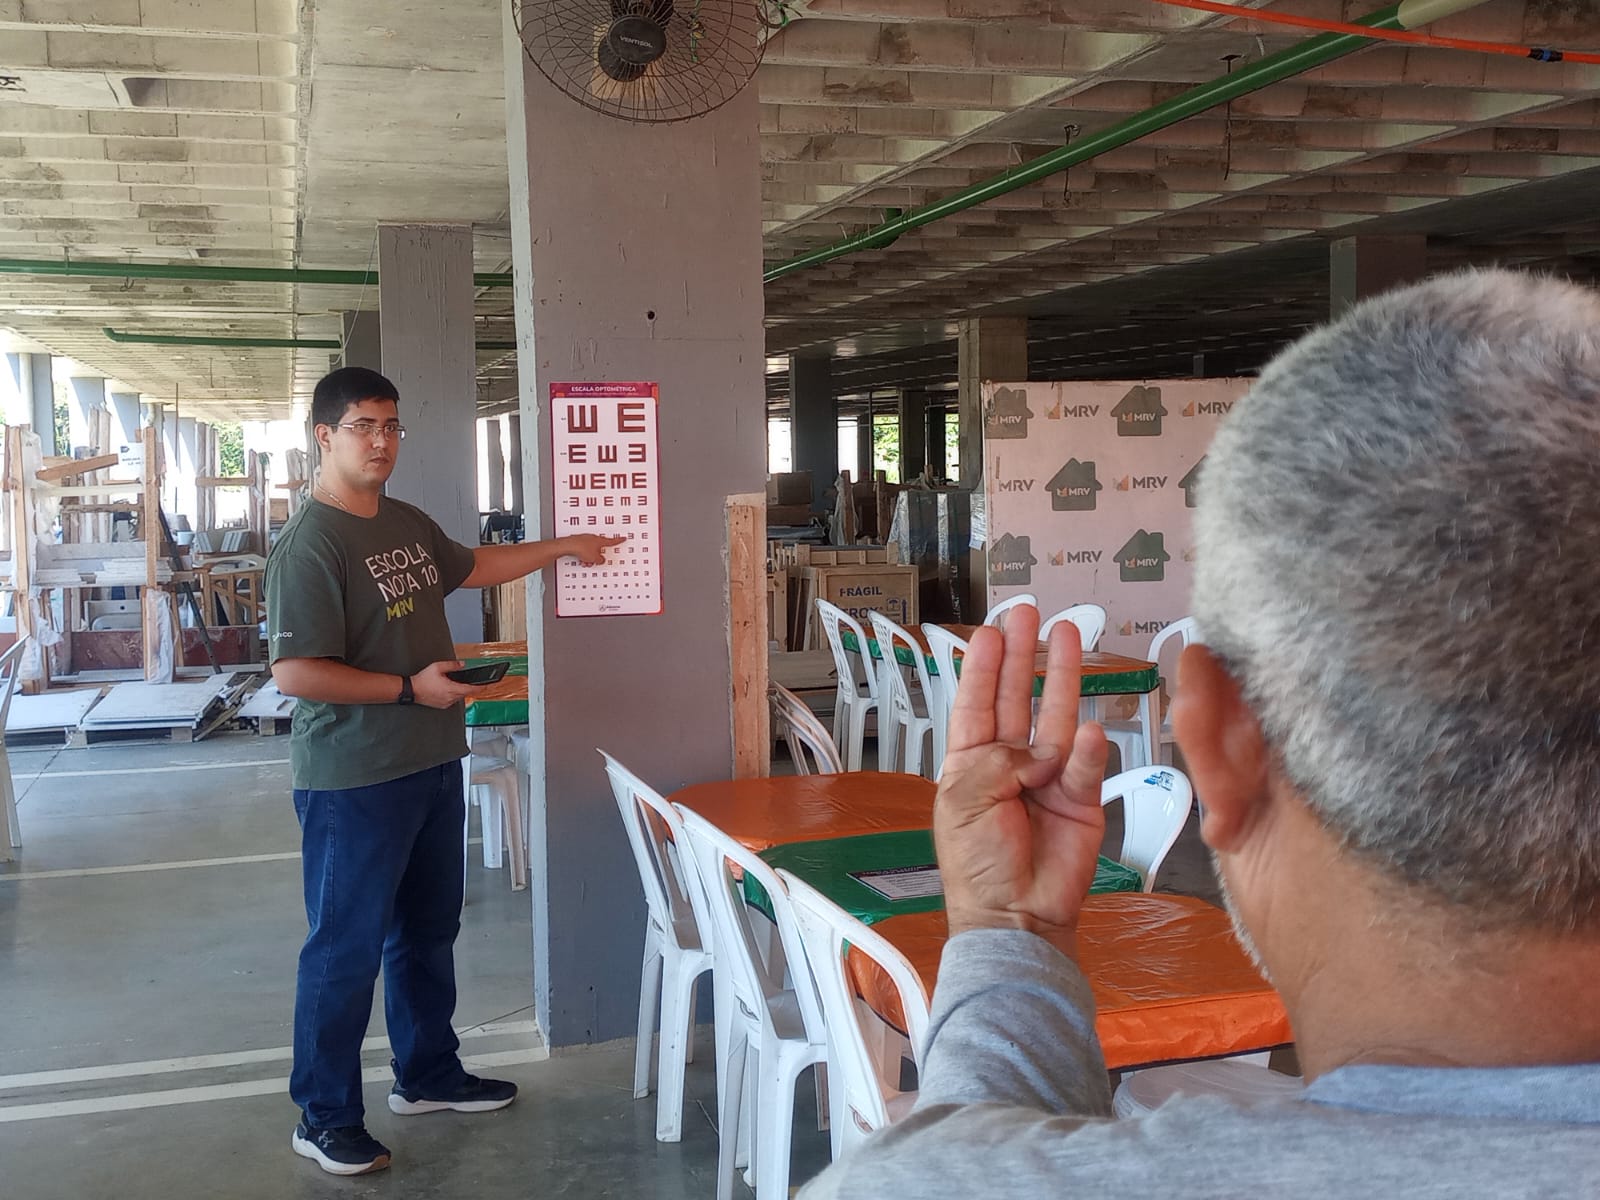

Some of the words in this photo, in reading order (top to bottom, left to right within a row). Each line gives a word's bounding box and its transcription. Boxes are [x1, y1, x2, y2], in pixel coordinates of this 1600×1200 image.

[1064, 405, 1100, 418] MRV
[1198, 401, 1234, 415] MRV
[1000, 415, 1022, 424] MRV
[1134, 413, 1156, 422] MRV
[999, 479, 1035, 492] MRV
[1132, 476, 1168, 489] MRV
[1068, 487, 1091, 496] MRV
[365, 543, 431, 579] ESCOLA
[1067, 551, 1102, 564] MRV
[1136, 558, 1159, 567] MRV
[1003, 562, 1026, 571] MRV
[377, 572, 421, 602] NOTA
[421, 565, 438, 587] 10
[386, 597, 414, 622] MRV
